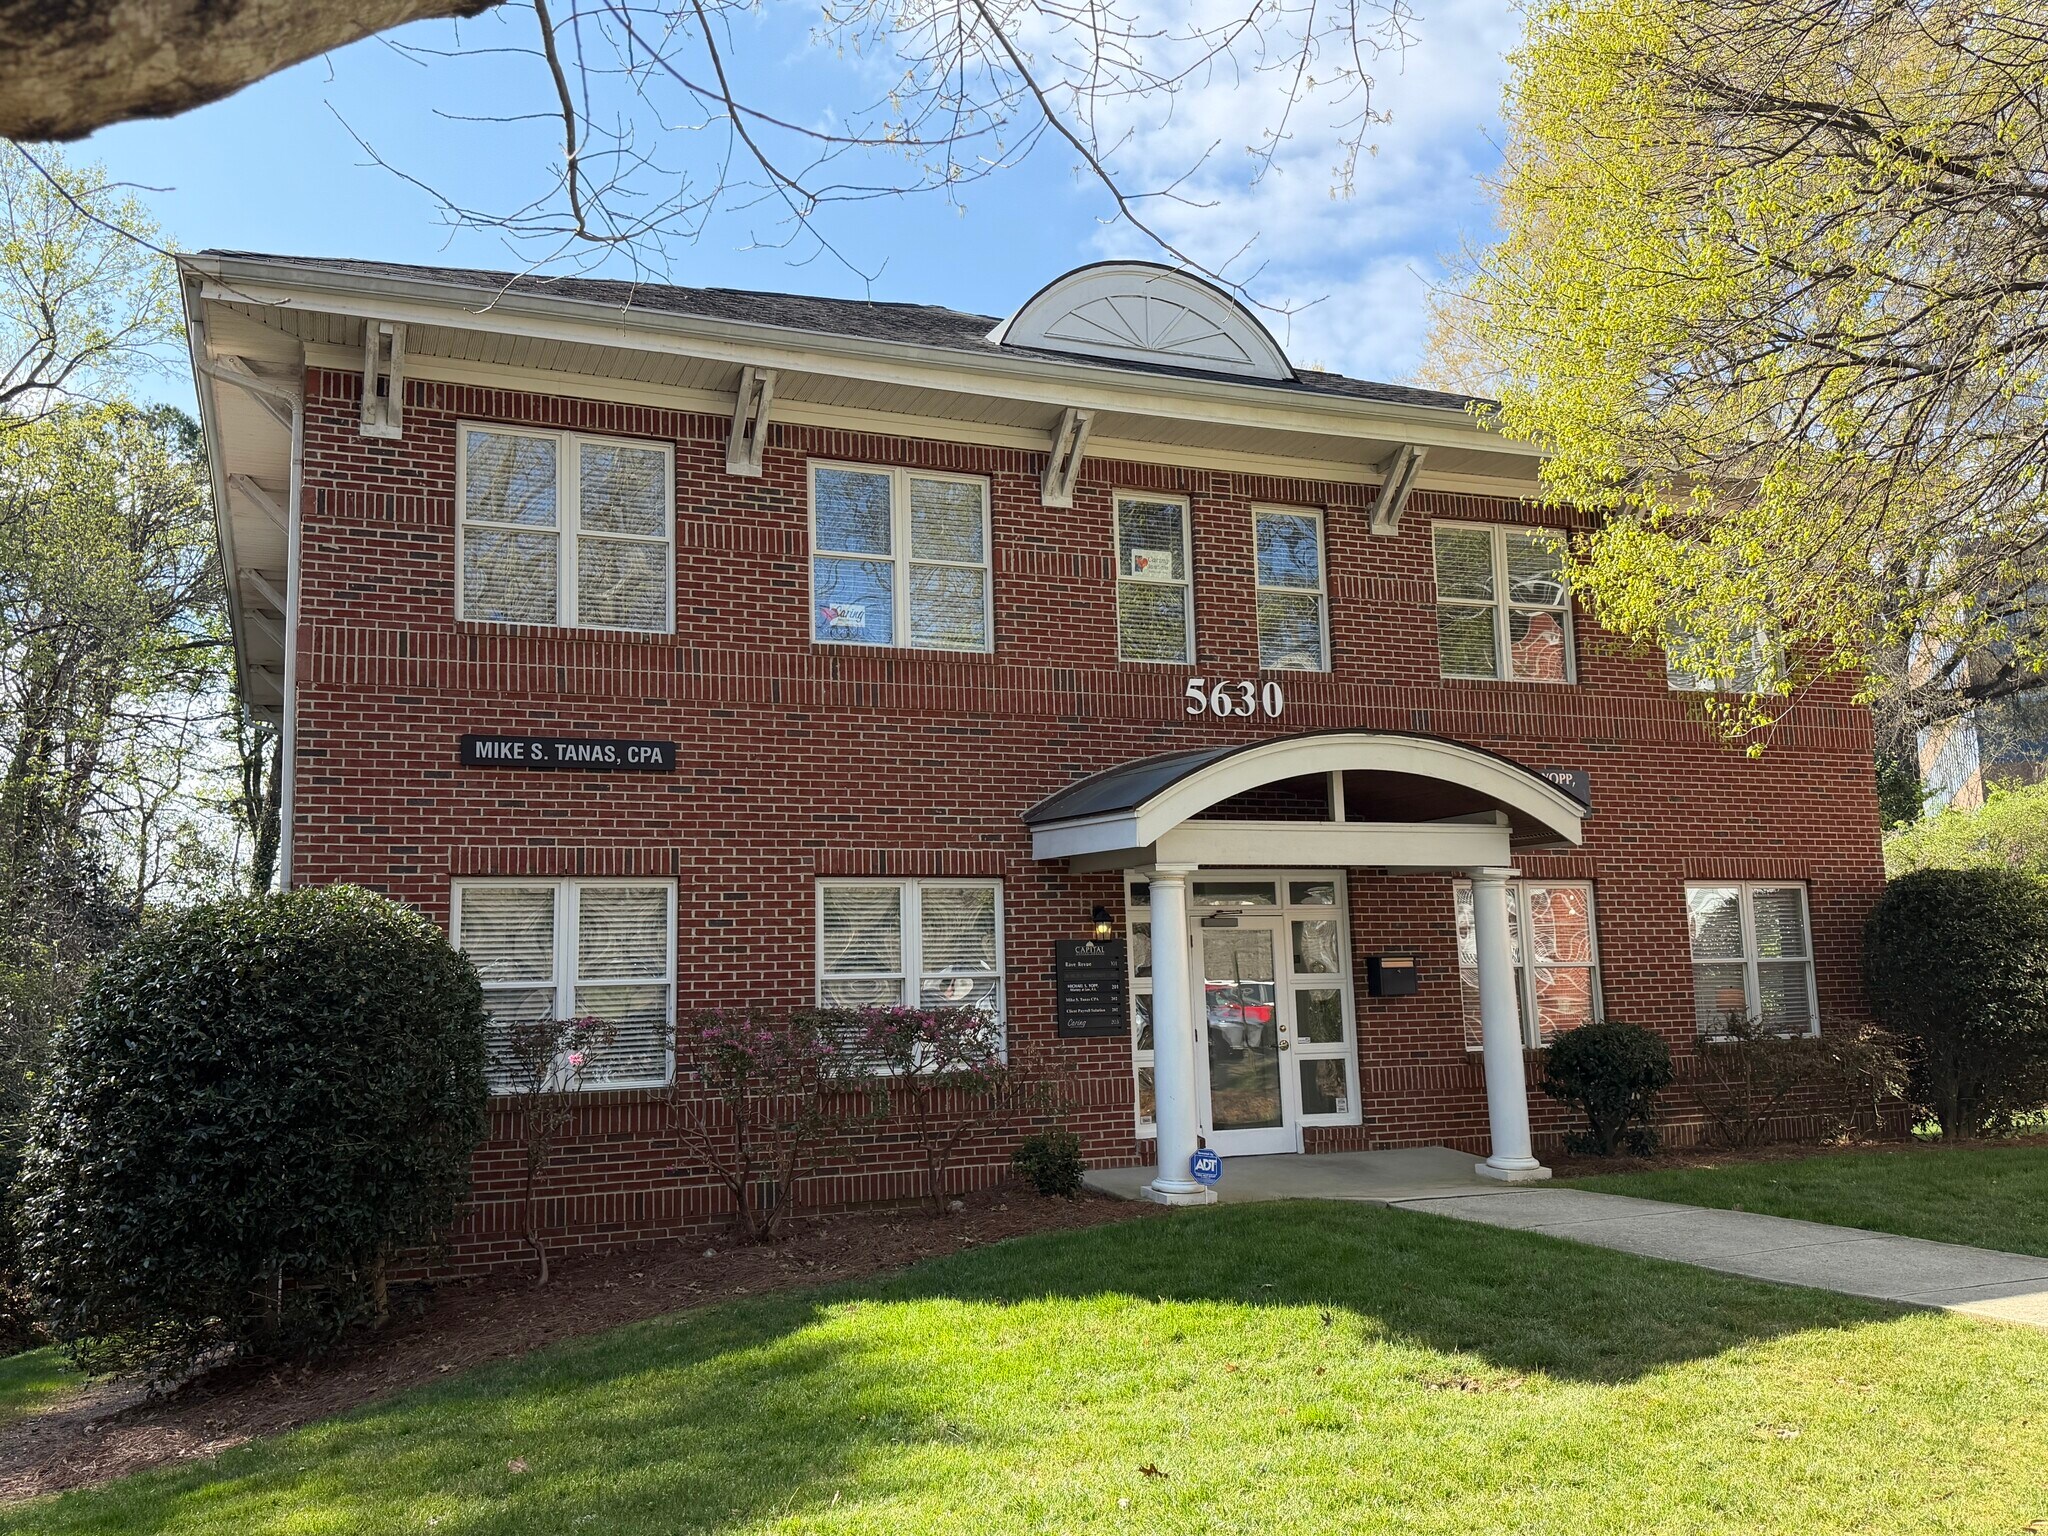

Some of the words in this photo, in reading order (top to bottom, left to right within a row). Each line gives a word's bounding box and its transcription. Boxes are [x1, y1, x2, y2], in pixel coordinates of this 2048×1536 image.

[1185, 678, 1283, 718] 5630
[475, 741, 524, 760] MIKE
[530, 743, 549, 760] S.
[555, 744, 621, 765] TANAS,
[627, 746, 663, 764] CPA
[1074, 946, 1105, 954] CAPITAL
[1195, 1159, 1217, 1172] ADT
